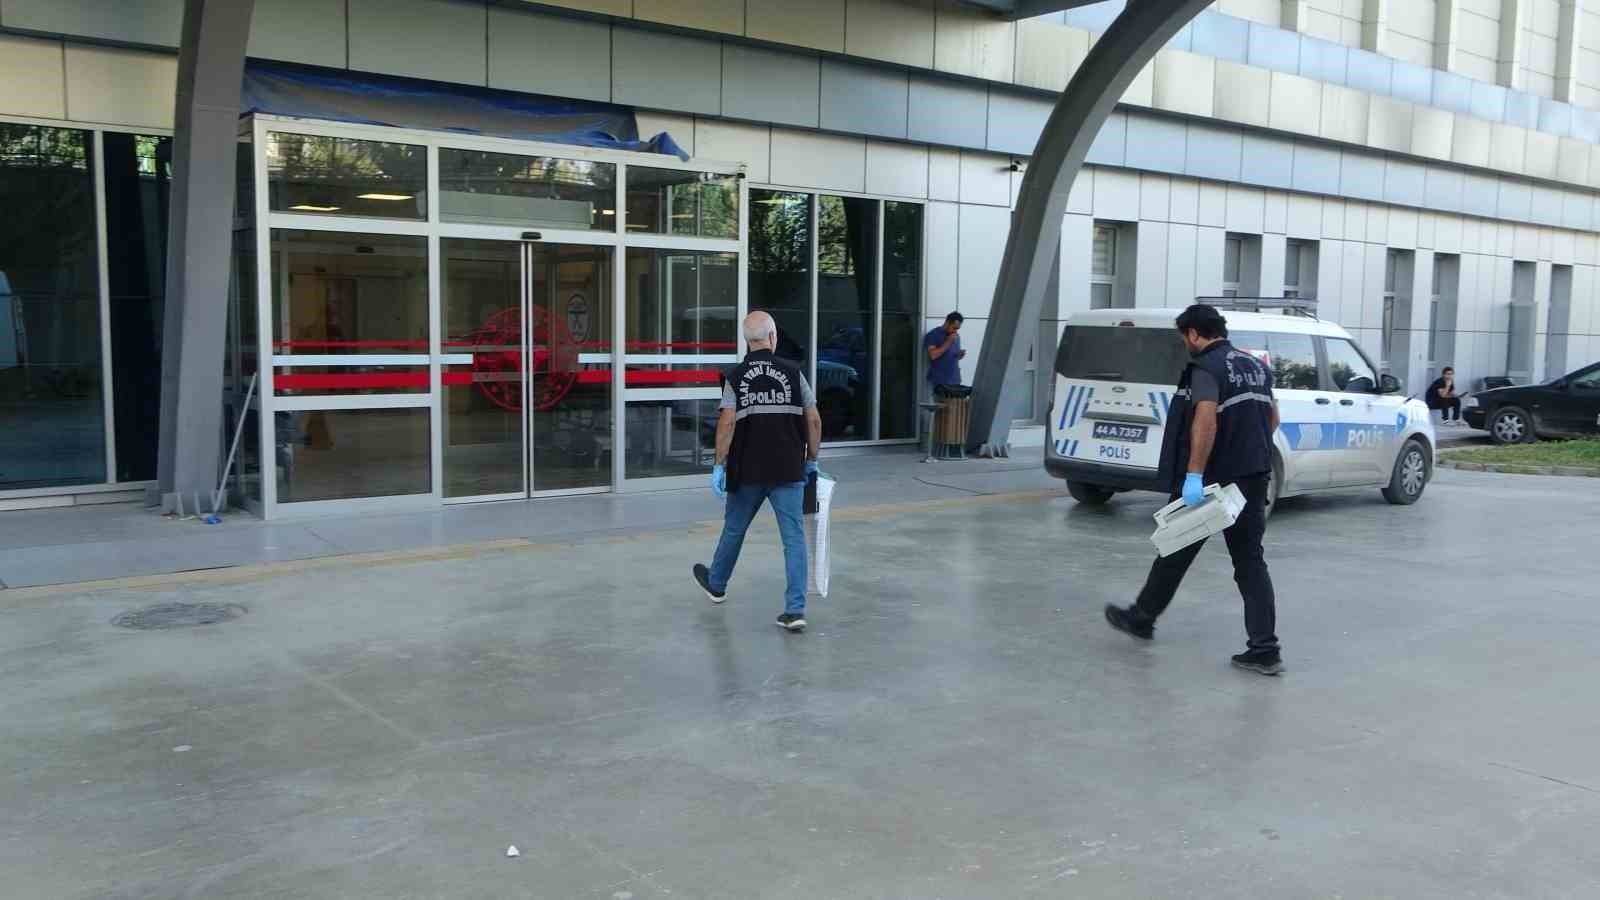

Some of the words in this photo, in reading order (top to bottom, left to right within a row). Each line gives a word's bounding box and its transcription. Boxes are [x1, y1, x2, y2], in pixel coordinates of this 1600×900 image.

[739, 381, 749, 406] OLAY
[748, 388, 785, 405] POLİS
[1095, 424, 1109, 434] 44
[1110, 426, 1118, 436] A
[1347, 424, 1385, 448] POLİS
[1099, 444, 1131, 460] POLİS
